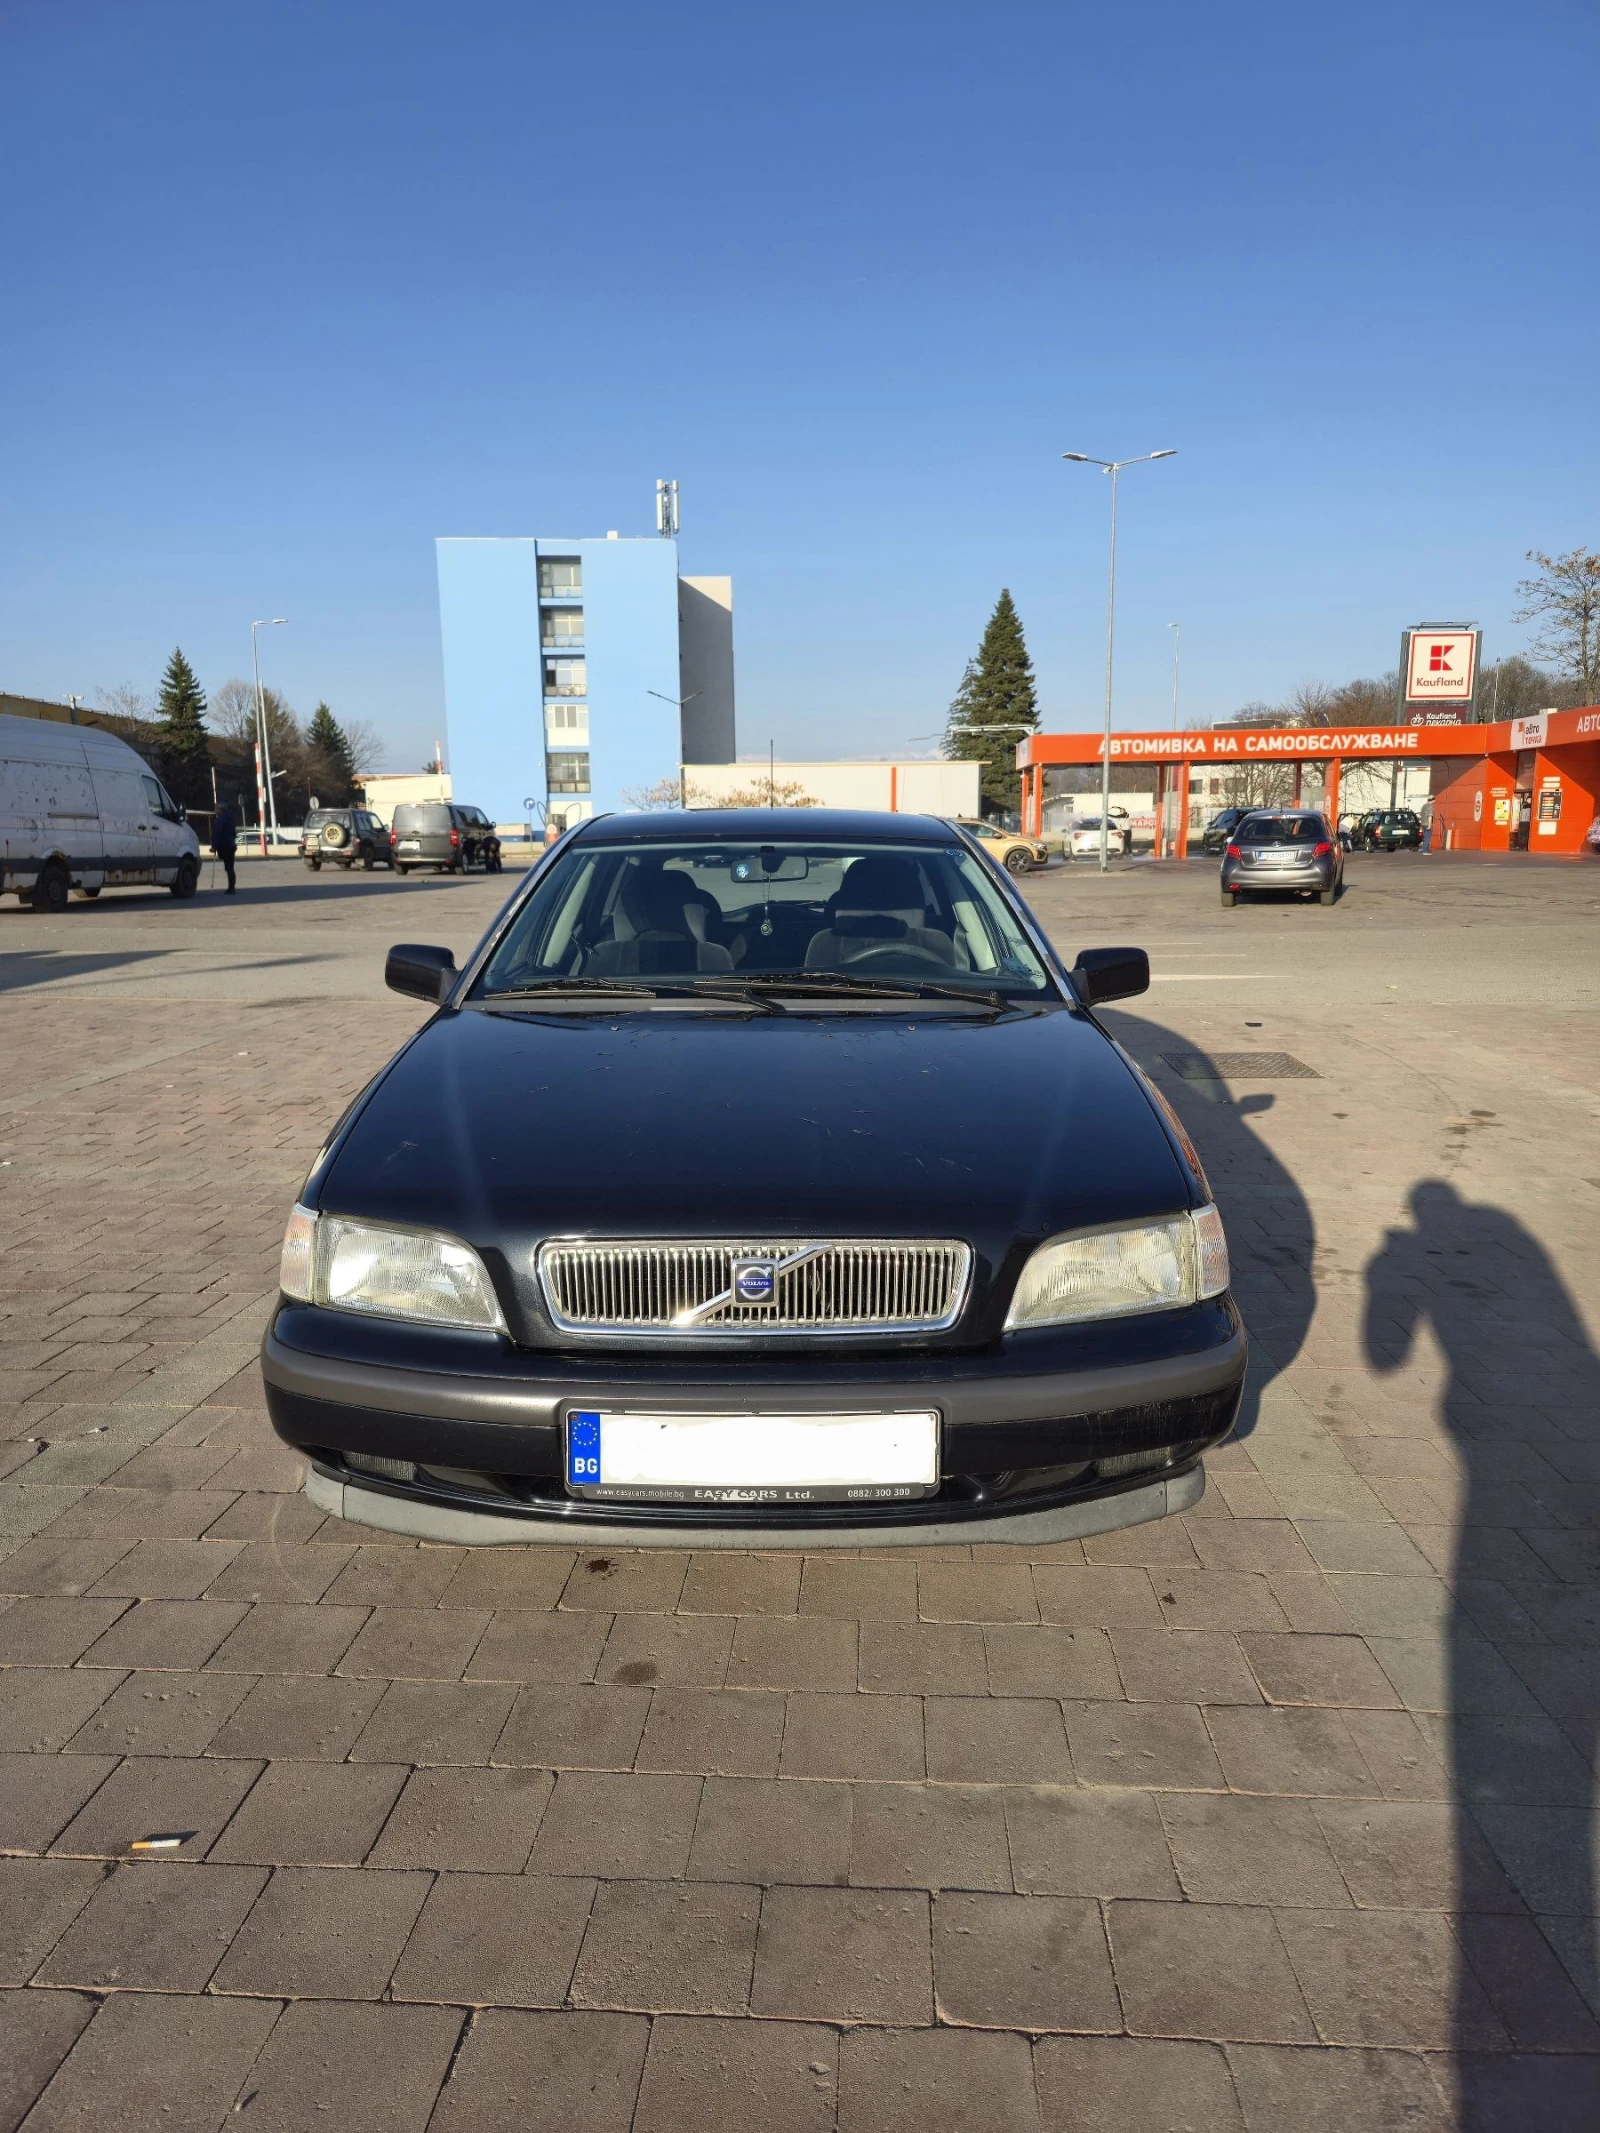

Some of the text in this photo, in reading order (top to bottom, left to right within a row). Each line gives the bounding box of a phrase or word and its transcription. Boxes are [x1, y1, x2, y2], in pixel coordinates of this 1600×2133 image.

[1416, 676, 1464, 687] Kaufland
[1426, 712, 1457, 720] Kaufland
[1213, 736, 1238, 752] НА
[1245, 733, 1419, 751] САМООБСЛУЖВАНЕ
[574, 1457, 598, 1474] BG
[596, 1487, 910, 1499] www.easycars.mobile.bg EASY CARS Ltd. 0882/ 300 300
